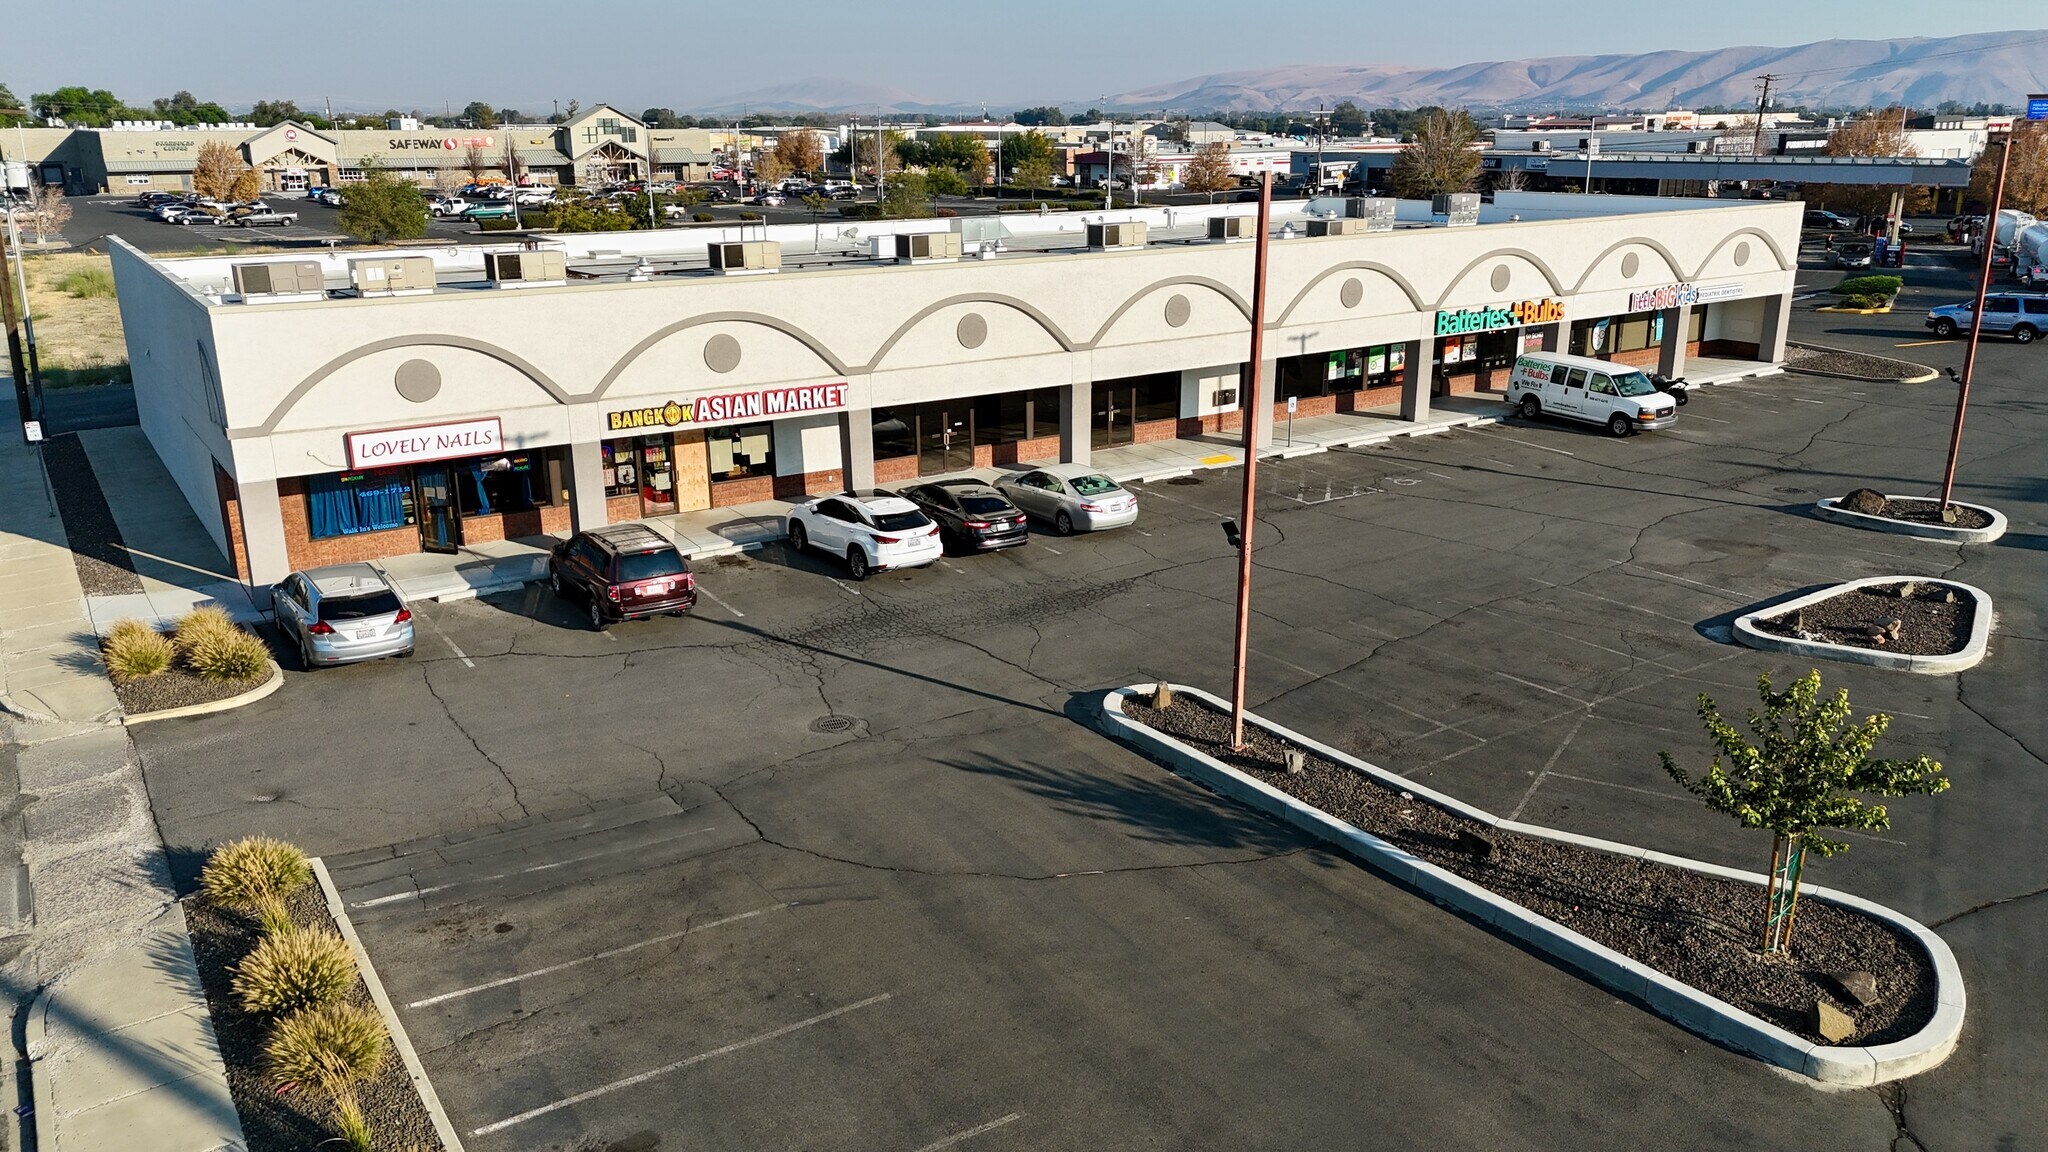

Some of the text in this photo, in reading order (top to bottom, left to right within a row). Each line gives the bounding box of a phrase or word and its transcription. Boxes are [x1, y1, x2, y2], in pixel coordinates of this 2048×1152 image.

[389, 139, 442, 150] SAFEWAY
[1633, 293, 1655, 311] little
[1677, 284, 1696, 305] kids
[1721, 288, 1743, 296] DENTISTRY
[1518, 358, 1551, 371] Batteries
[610, 384, 848, 429] BANGKOK ASIAN MARKET
[361, 430, 492, 458] LOVELY NAILS
[359, 486, 411, 498] 469-1712
